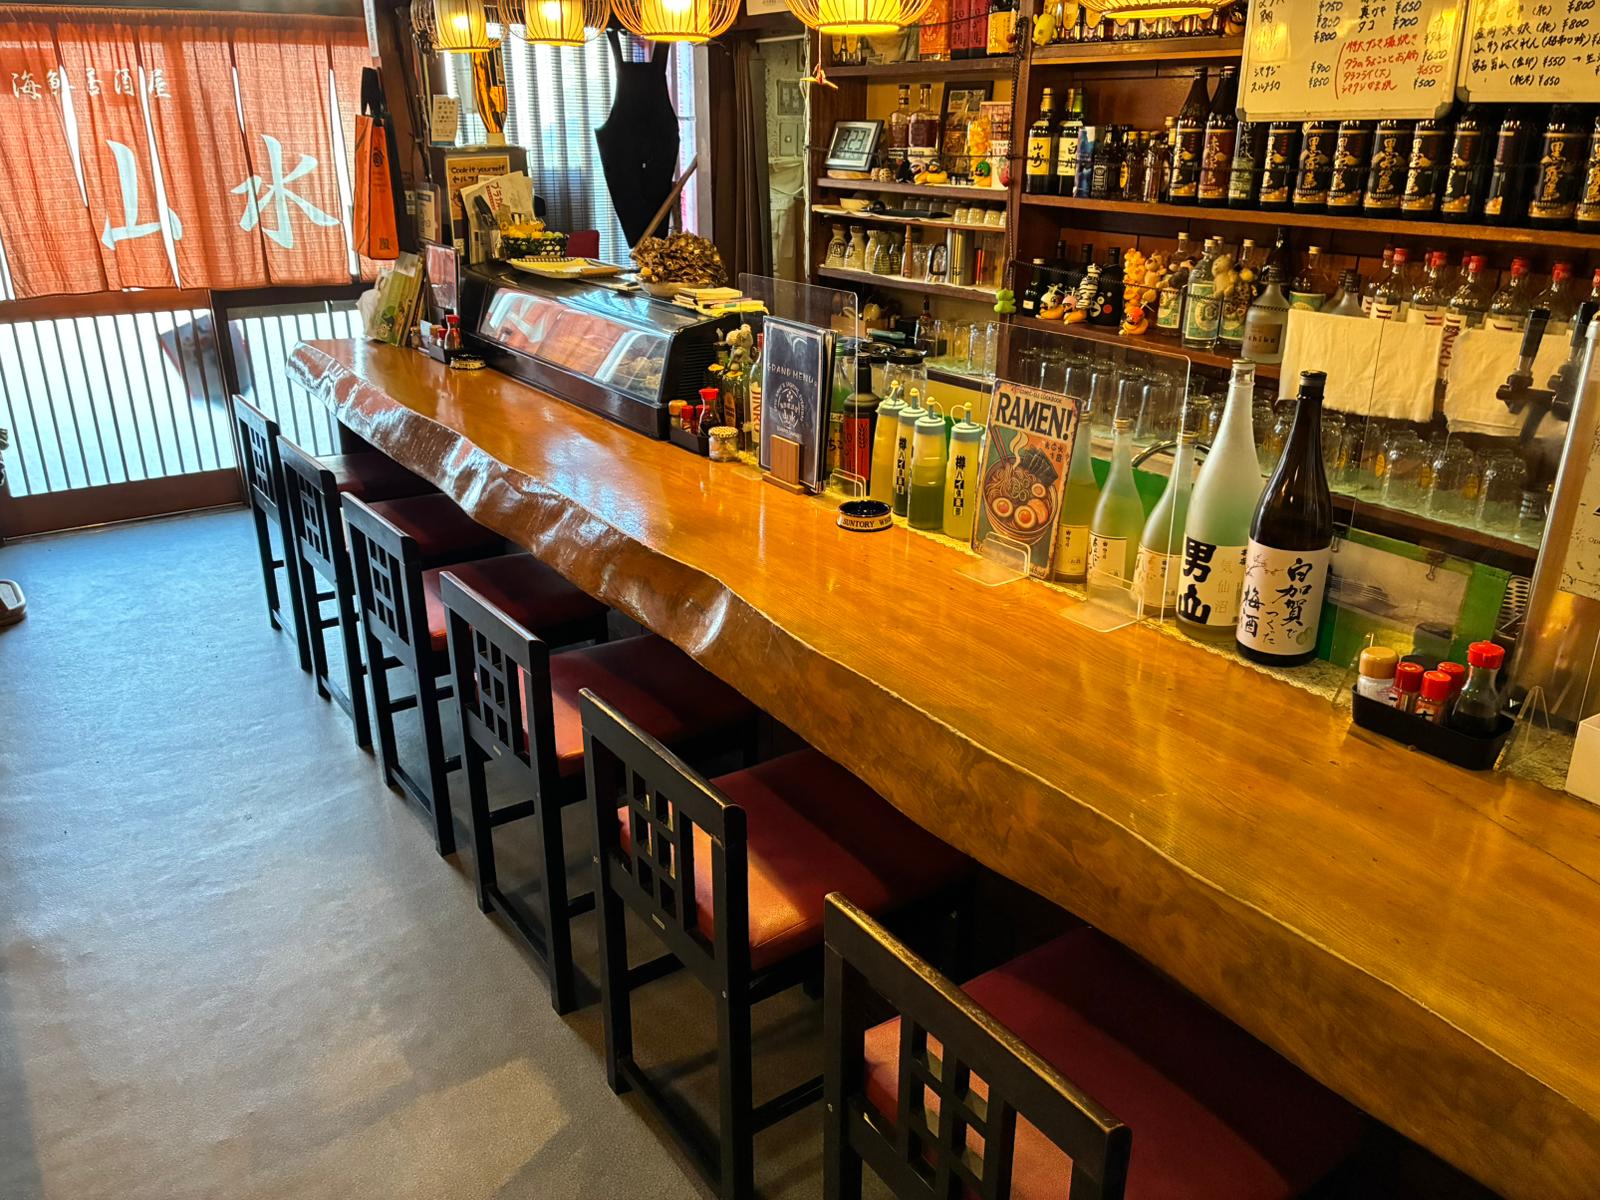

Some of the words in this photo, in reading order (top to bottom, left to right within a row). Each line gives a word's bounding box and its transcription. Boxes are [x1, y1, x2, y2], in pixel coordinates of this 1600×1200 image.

[995, 391, 1073, 441] RAMEN!
[842, 516, 875, 529] SUNTORY
[1178, 536, 1217, 624] 男山
